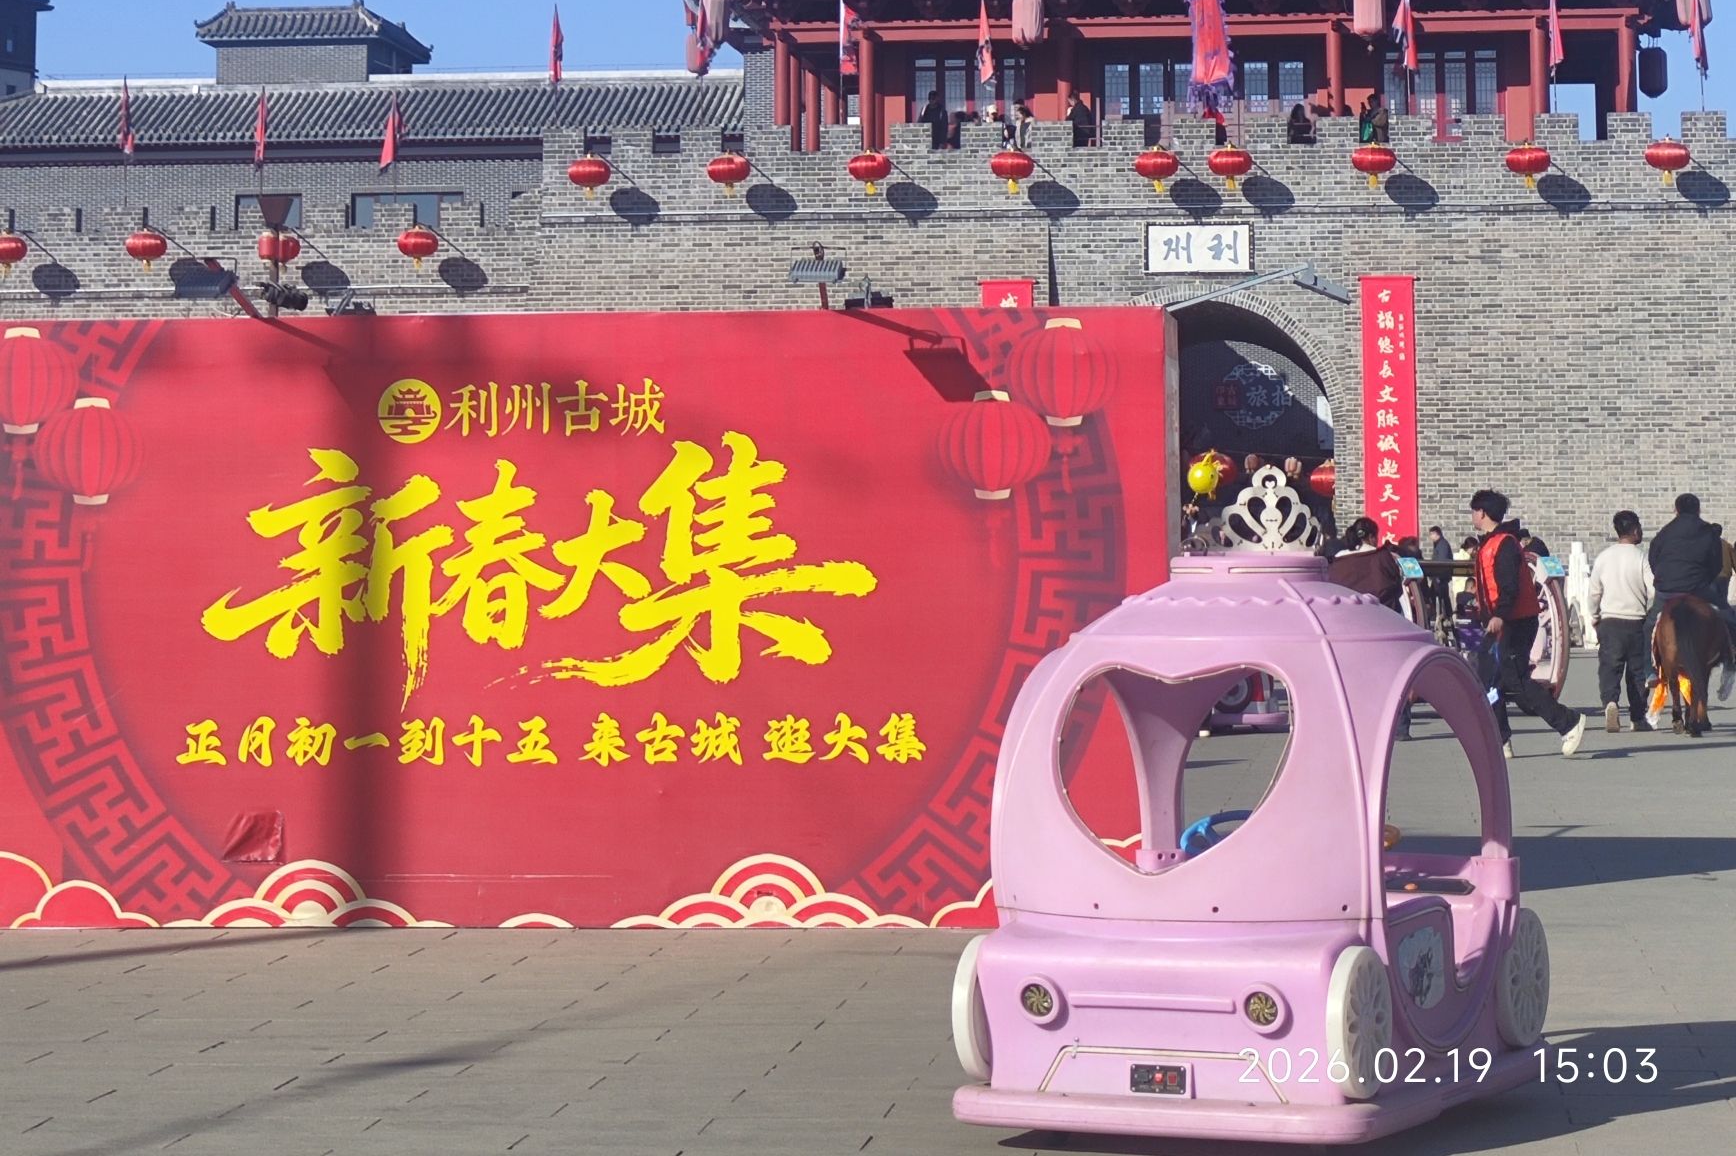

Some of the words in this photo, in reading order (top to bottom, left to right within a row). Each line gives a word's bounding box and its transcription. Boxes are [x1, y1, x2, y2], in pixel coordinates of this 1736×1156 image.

[444, 378, 667, 437] 利州古城
[201, 432, 878, 712] 新春大集
[177, 715, 558, 767] 正月初一到十五
[578, 712, 743, 767] 来古城
[762, 712, 927, 764] 逛大集
